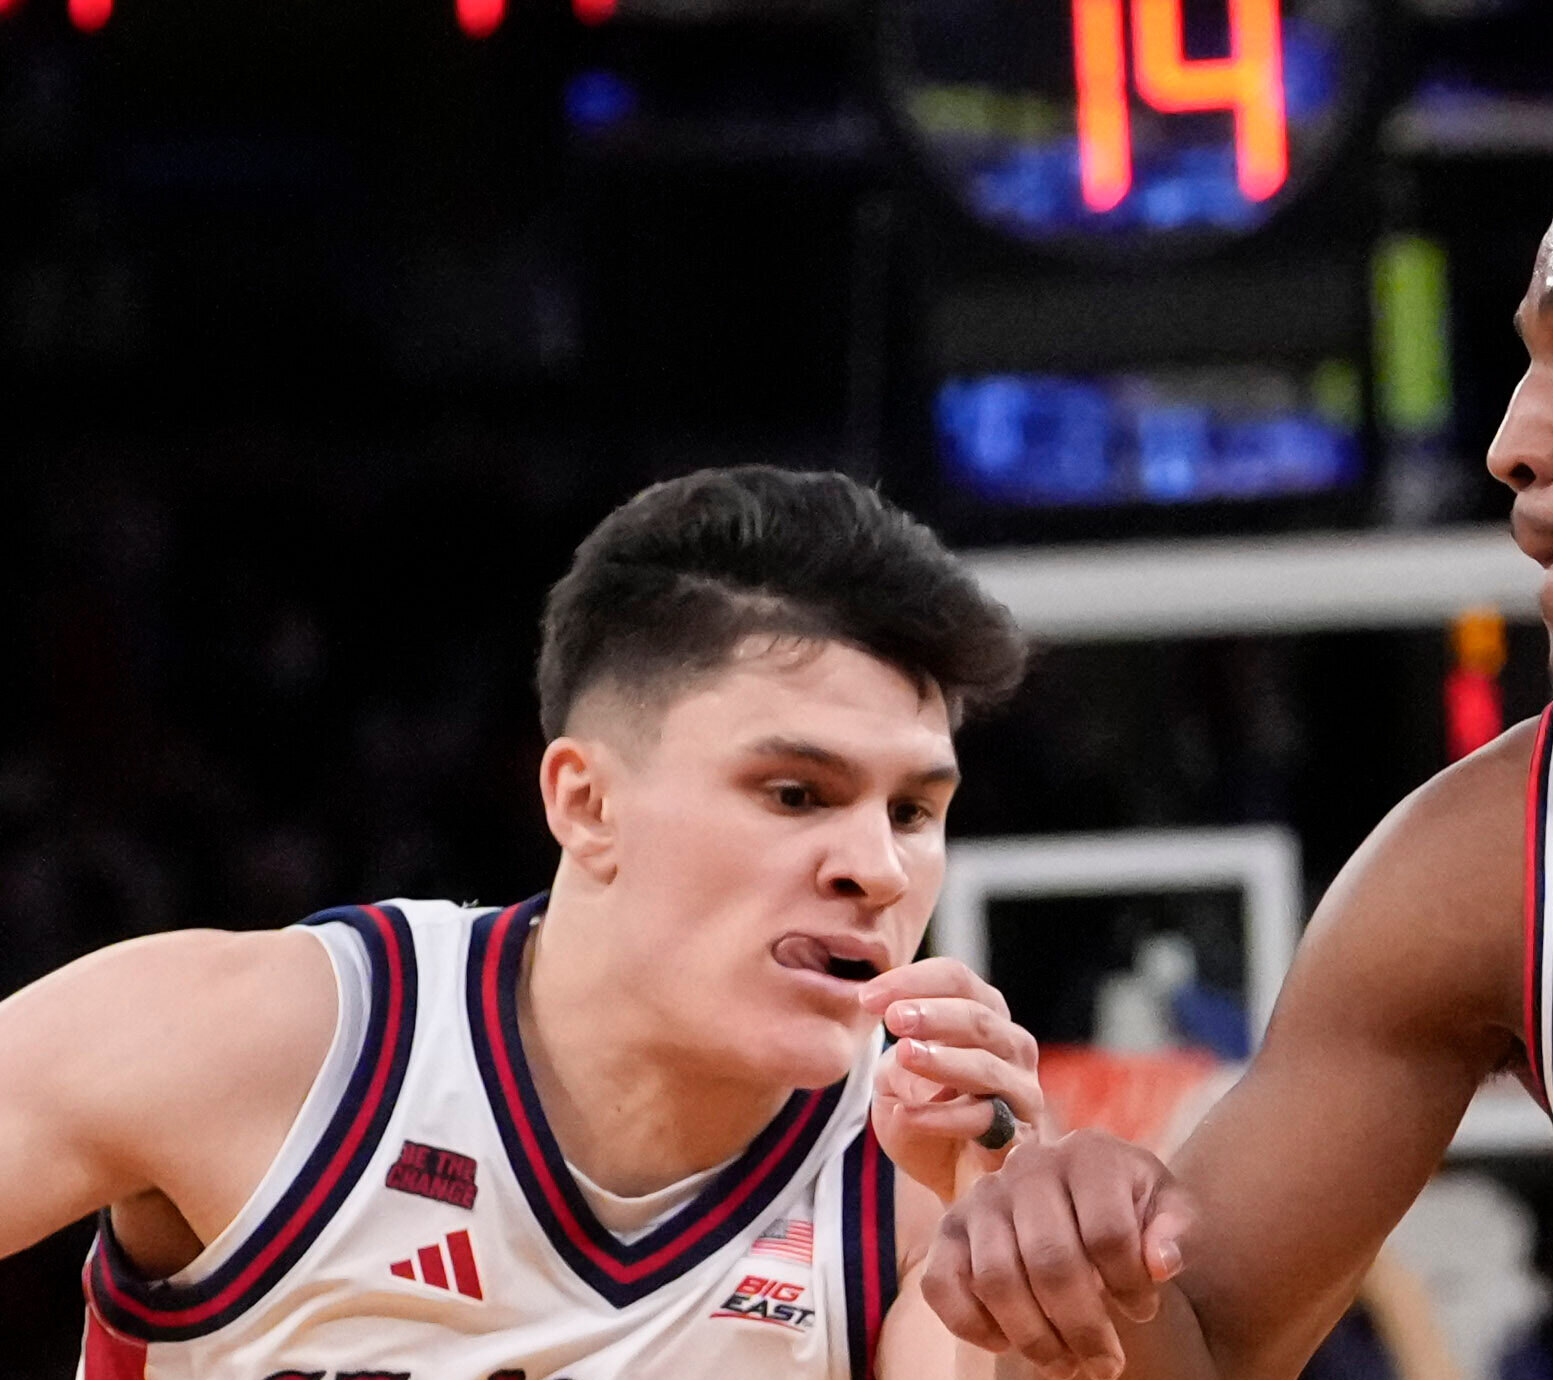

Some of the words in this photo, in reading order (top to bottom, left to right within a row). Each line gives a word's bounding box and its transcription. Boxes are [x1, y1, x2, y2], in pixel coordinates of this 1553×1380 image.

[1070, 0, 1290, 213] 14
[736, 1274, 805, 1303] BIG
[719, 1292, 816, 1325] EAST
